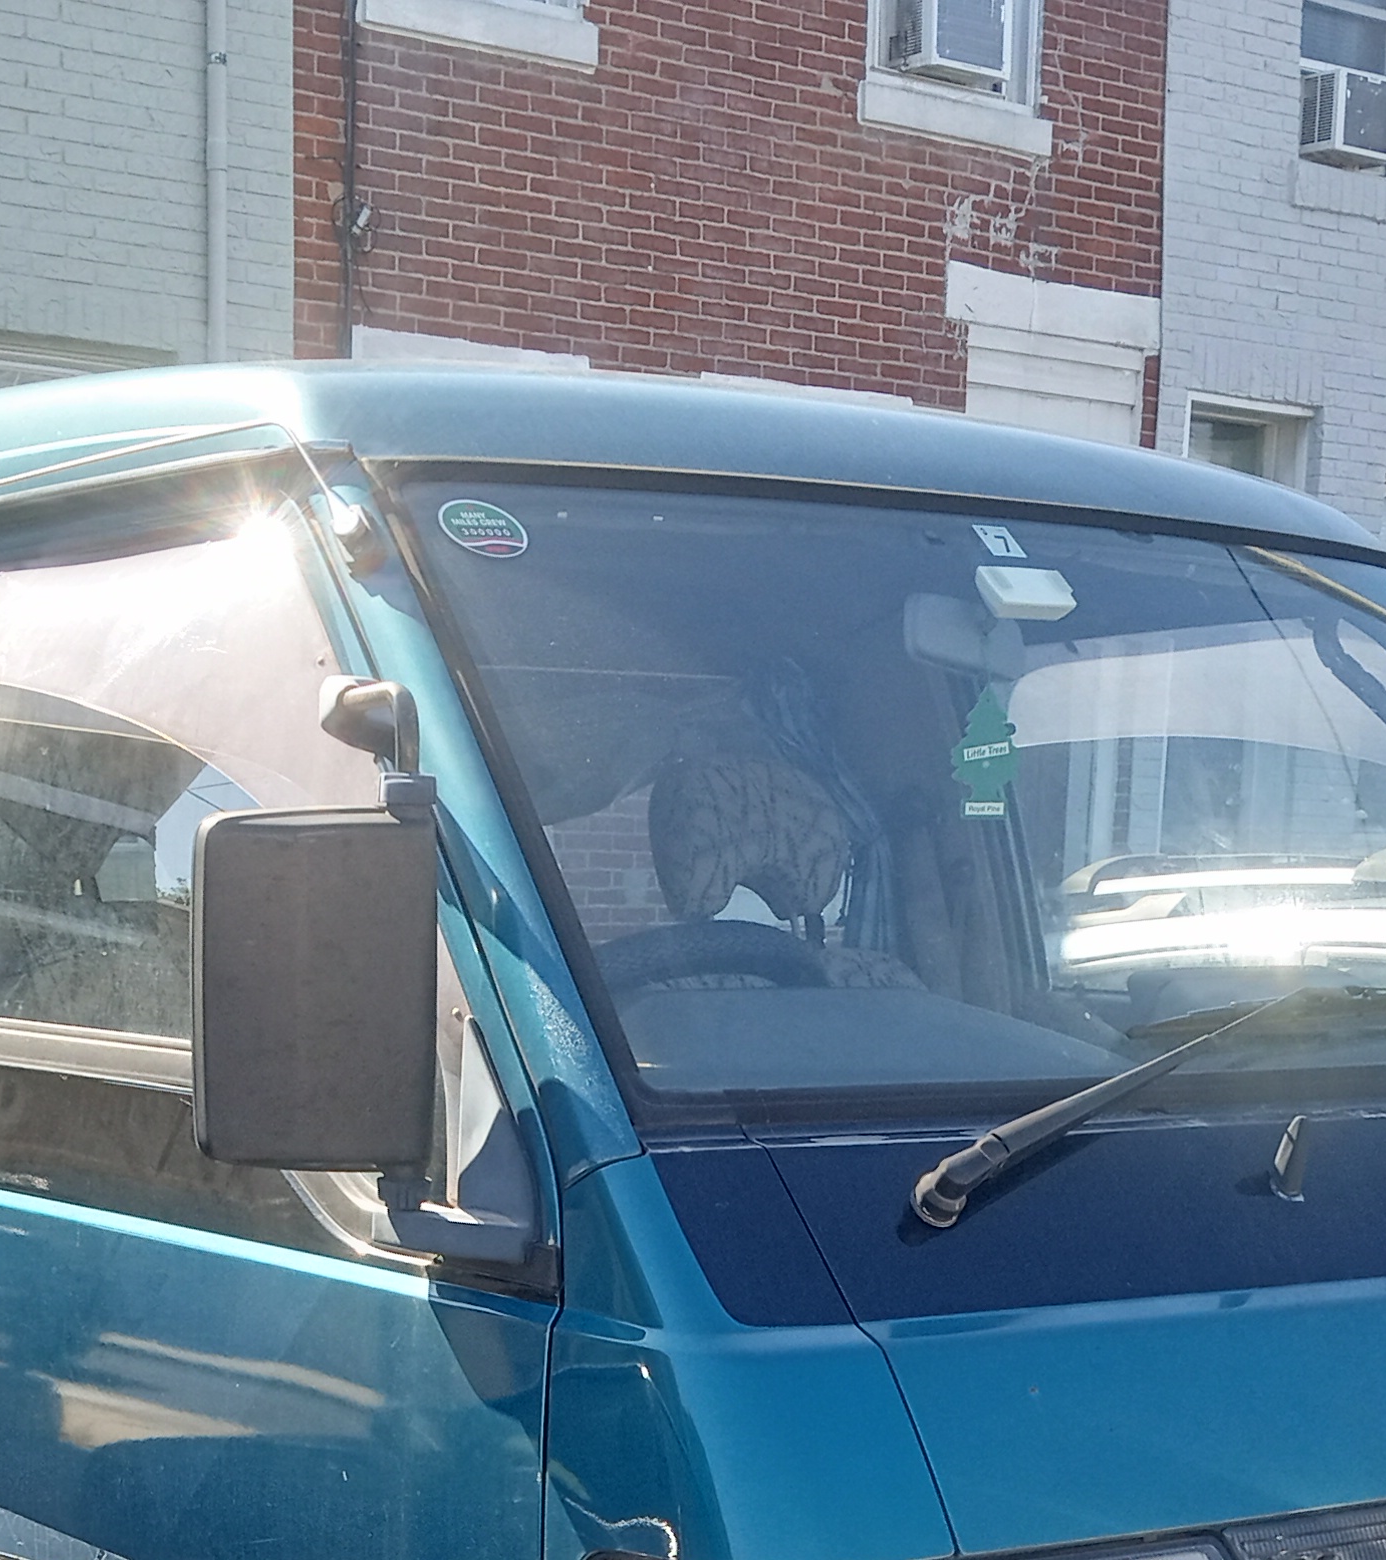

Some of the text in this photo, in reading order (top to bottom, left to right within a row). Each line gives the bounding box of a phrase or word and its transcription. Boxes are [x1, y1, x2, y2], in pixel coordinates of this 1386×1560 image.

[459, 511, 486, 520] MANY
[450, 518, 479, 526] MILES
[993, 534, 1011, 553] 7
[966, 745, 1008, 760] Little Trees
[968, 805, 986, 813] Royal
